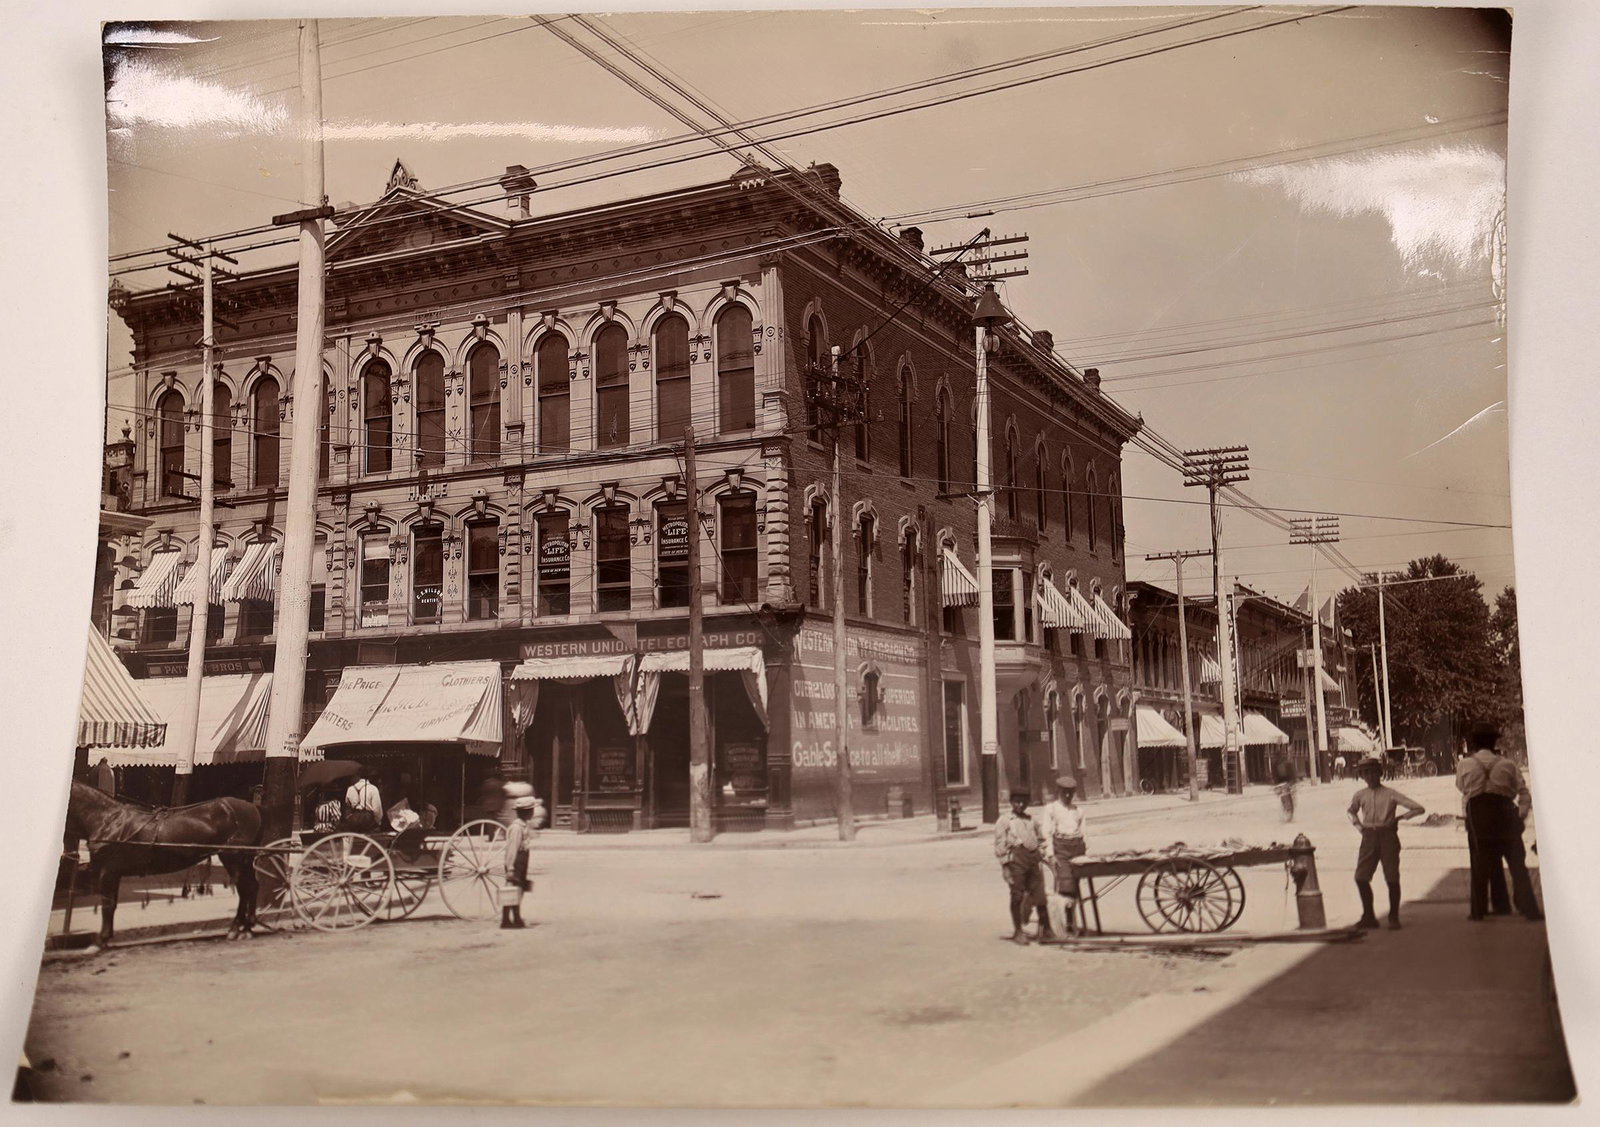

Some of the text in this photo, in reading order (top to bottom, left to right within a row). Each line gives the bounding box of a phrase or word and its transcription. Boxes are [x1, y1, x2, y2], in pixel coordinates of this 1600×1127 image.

[407, 483, 447, 501] HITLE
[524, 643, 587, 657] WESTERN
[638, 634, 728, 651] TELEGAPH
[793, 629, 834, 661] WESTERN
[165, 662, 243, 674] PATTN BROS
[353, 677, 382, 690] PRICE
[441, 675, 490, 687] CLOTHIERS
[794, 680, 813, 698] OVER
[794, 711, 853, 730] IN AMERA
[877, 715, 920, 733] FACILITIES
[823, 741, 860, 767] Sece
